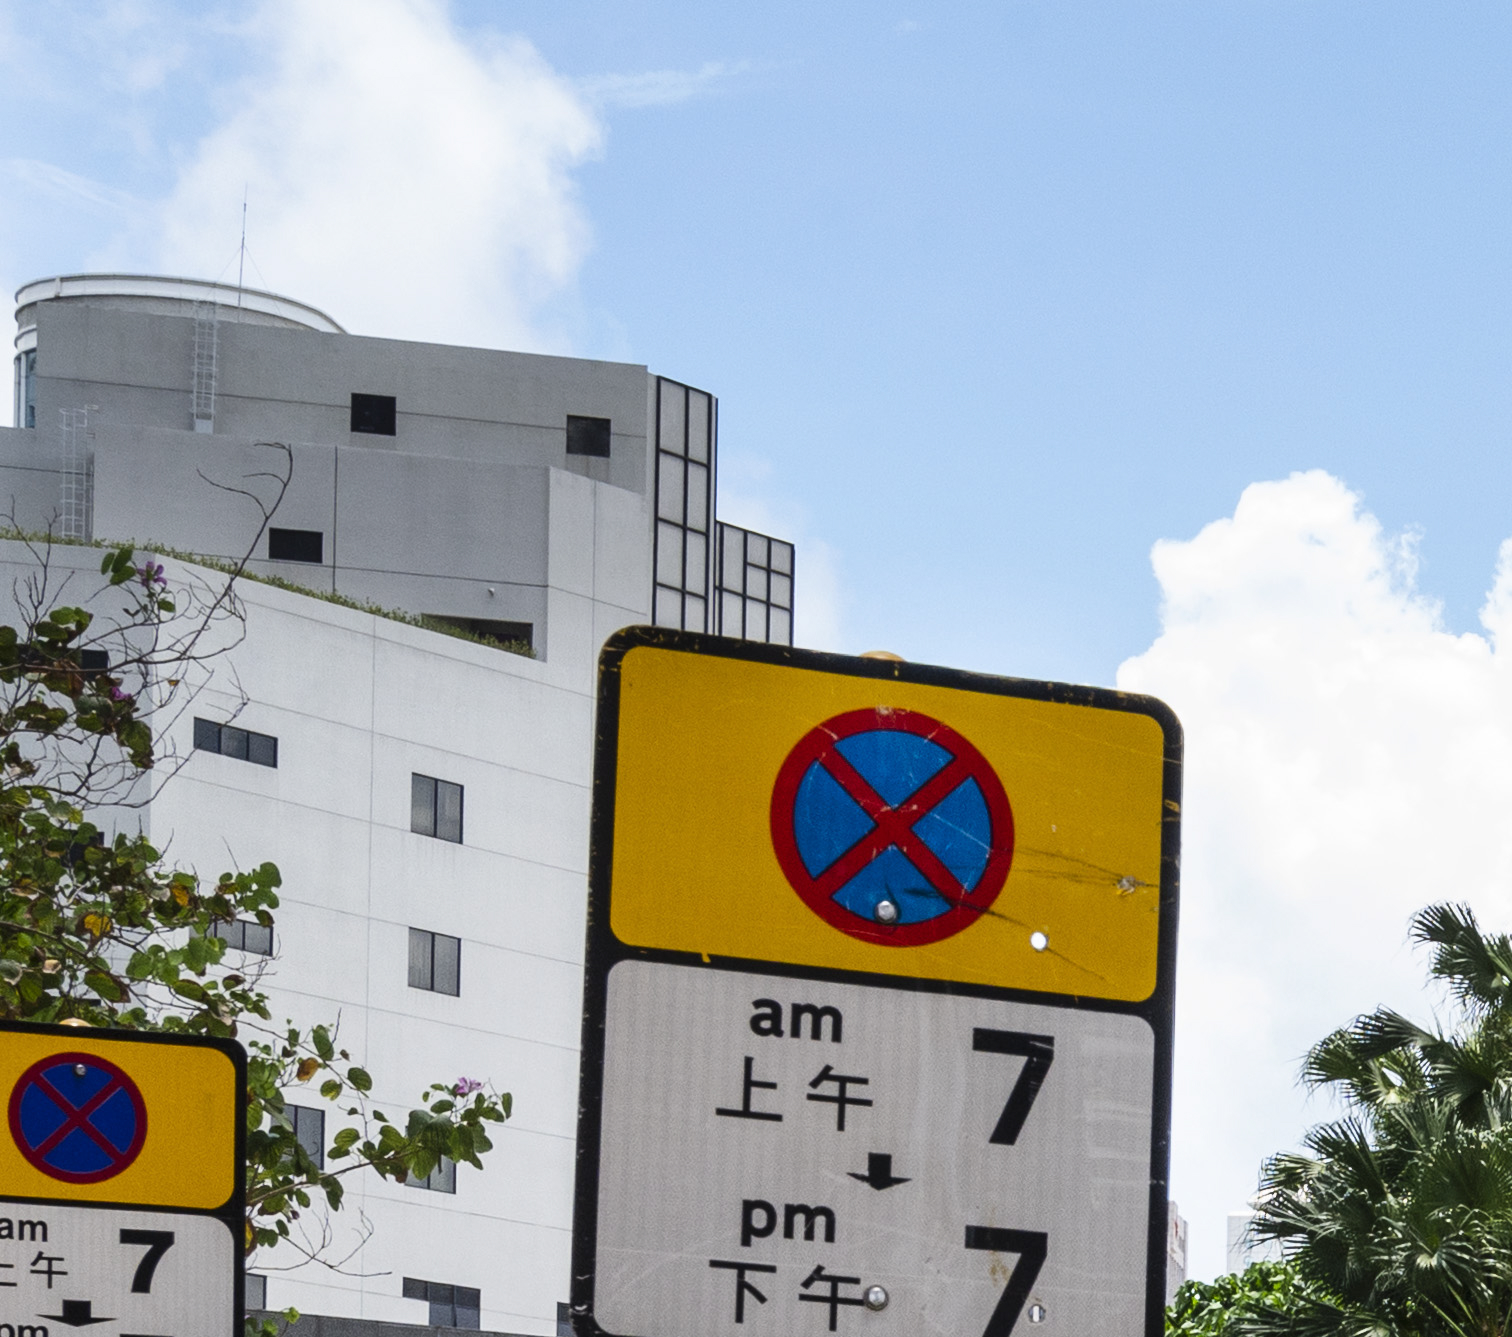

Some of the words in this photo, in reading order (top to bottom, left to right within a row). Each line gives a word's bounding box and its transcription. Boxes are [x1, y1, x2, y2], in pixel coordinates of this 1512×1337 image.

[750, 997, 843, 1043] am
[715, 1056, 874, 1133] 上午
[972, 1026, 1055, 1146] 7
[741, 1192, 836, 1248] pm
[119, 1228, 175, 1294] 7
[709, 1258, 868, 1332] 下午
